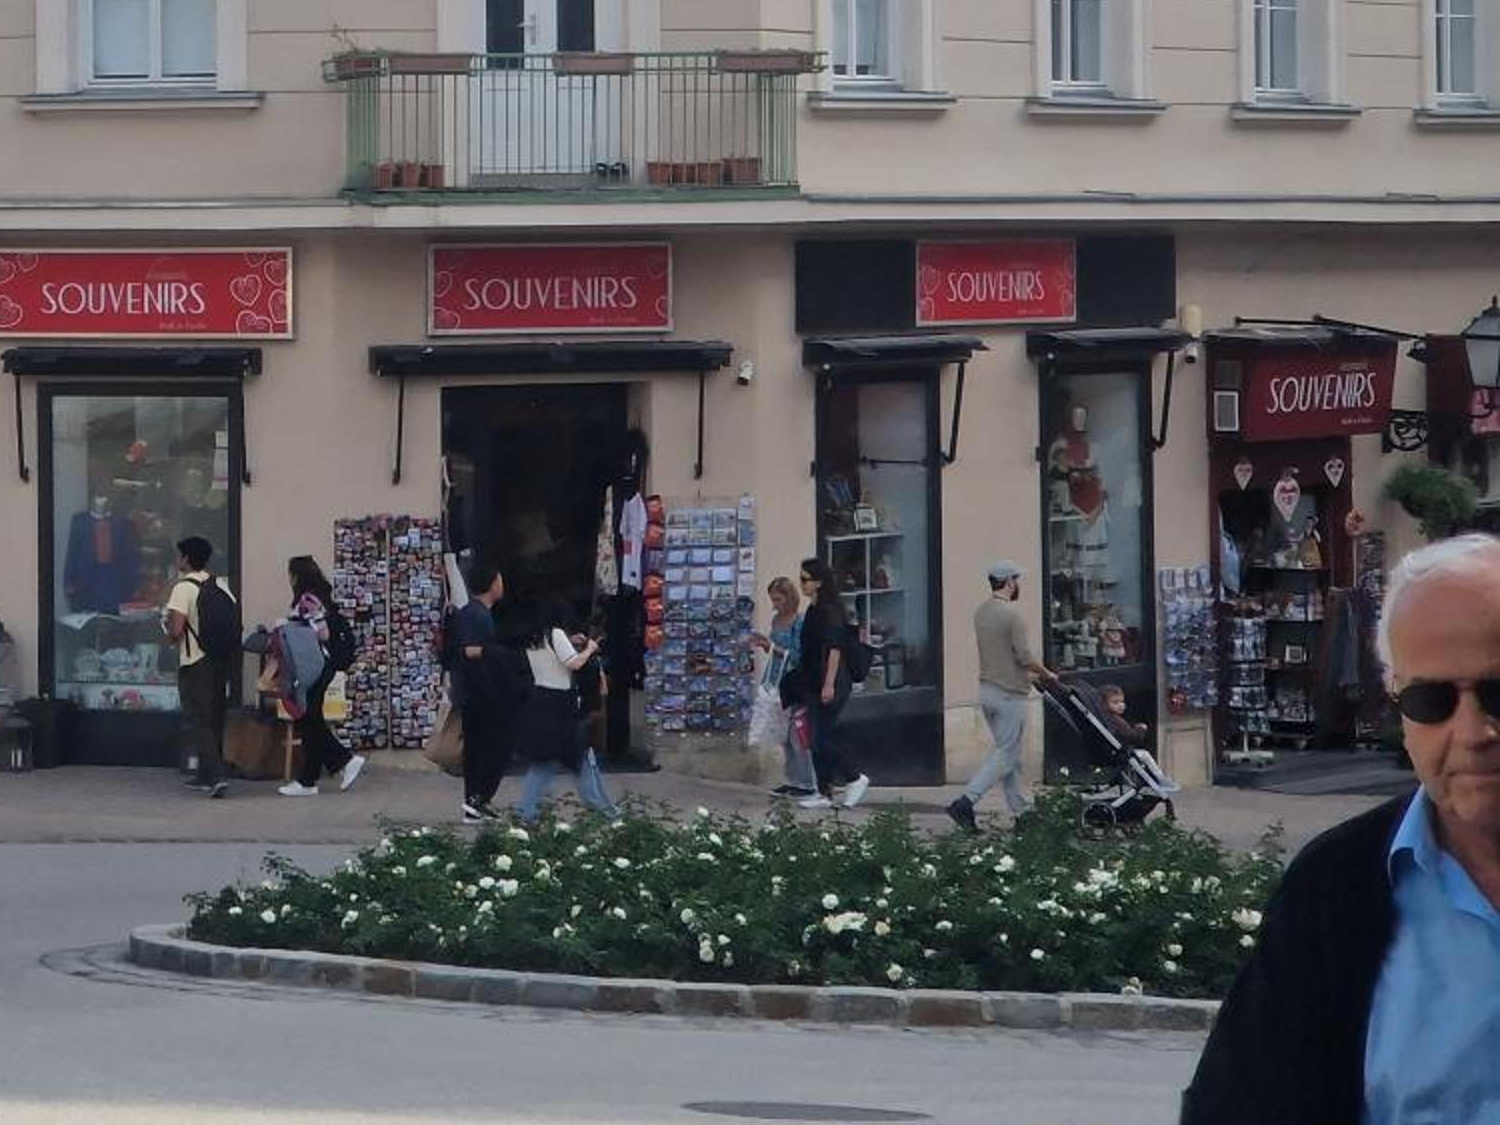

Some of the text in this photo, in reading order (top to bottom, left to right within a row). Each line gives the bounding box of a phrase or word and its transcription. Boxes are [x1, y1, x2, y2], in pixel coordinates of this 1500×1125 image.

[40, 282, 206, 315] SOUVENIRS
[464, 276, 638, 310] SOUVENIRS
[947, 271, 1045, 303] SOUVENIRS
[1267, 372, 1377, 414] SOUVENIRS
